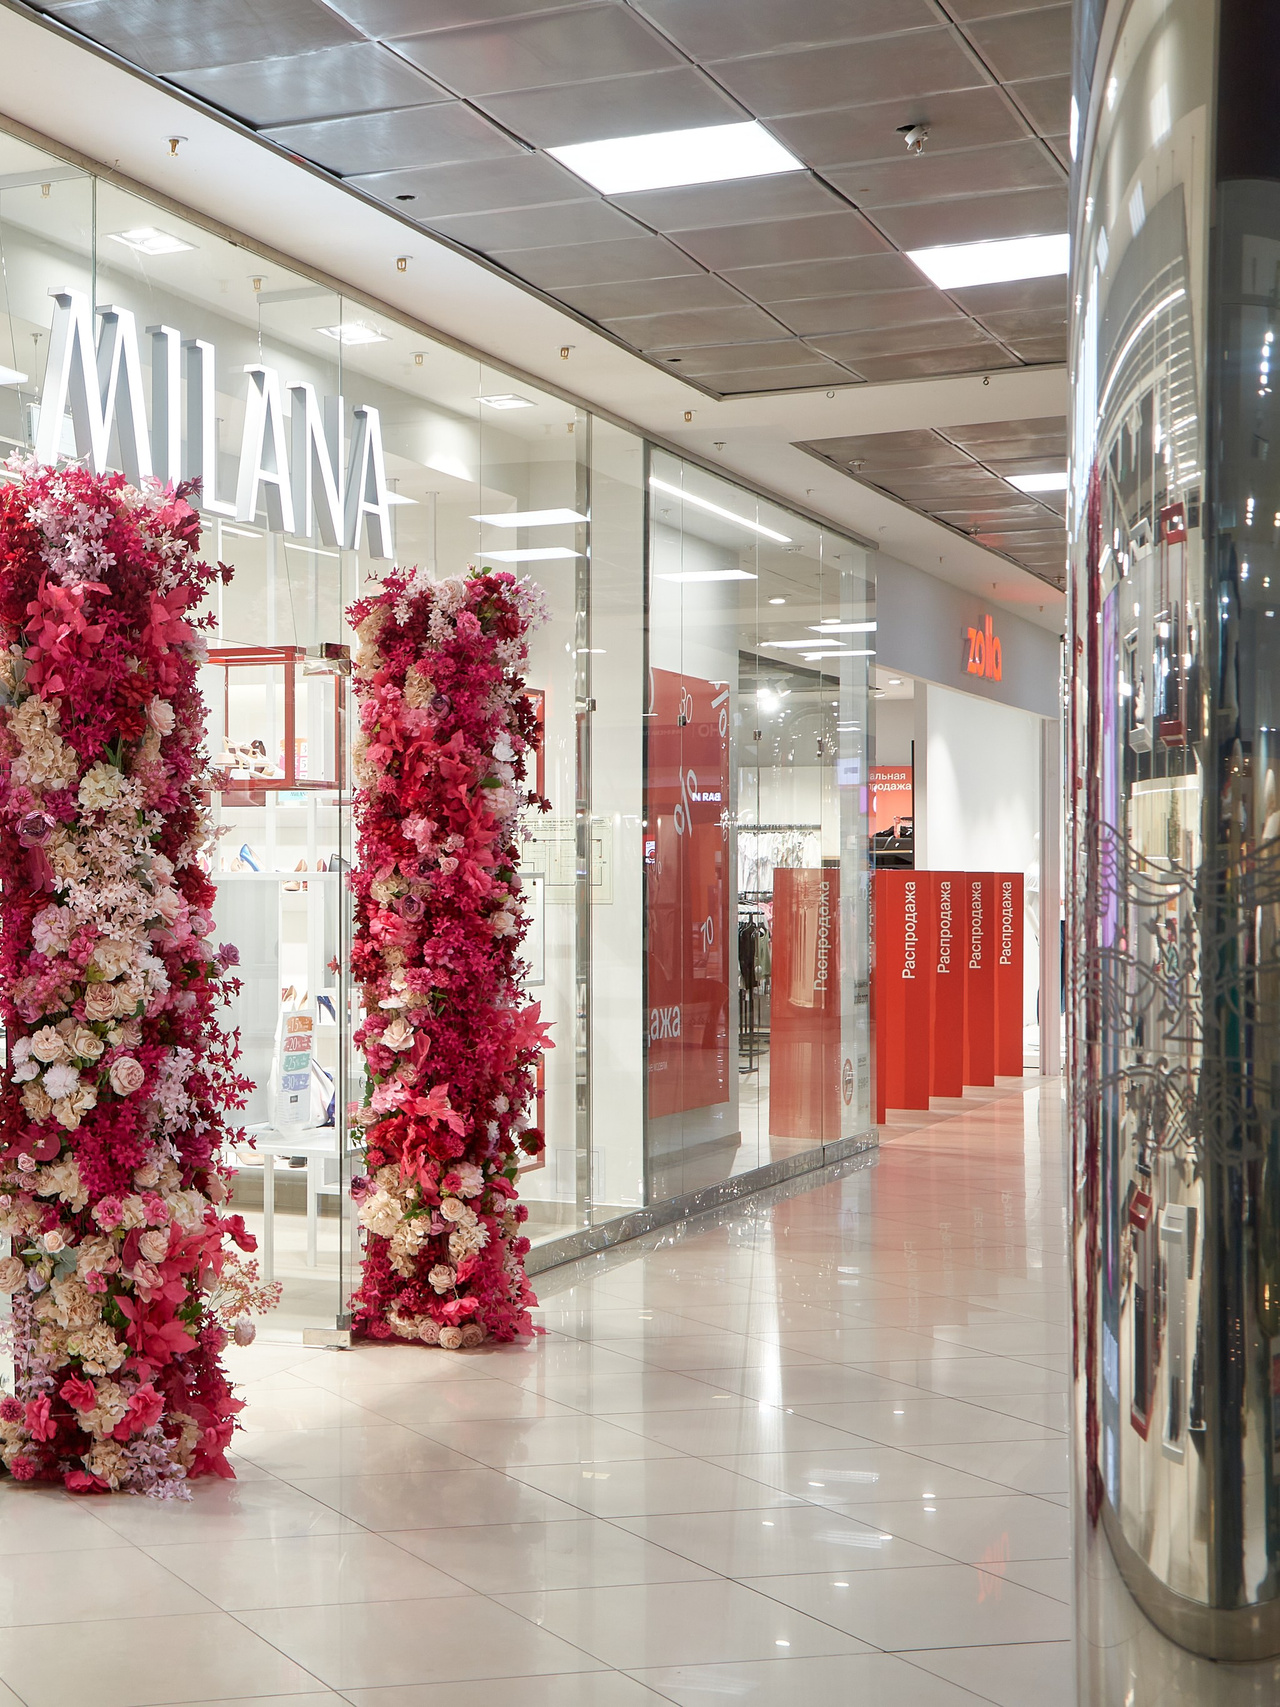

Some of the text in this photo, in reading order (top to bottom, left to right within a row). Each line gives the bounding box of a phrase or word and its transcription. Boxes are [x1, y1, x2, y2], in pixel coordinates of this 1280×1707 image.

[34, 285, 394, 560] MILANA
[966, 613, 1002, 682] zolla
[813, 881, 832, 991] Распродажа
[901, 881, 919, 979] Распродажа
[937, 881, 954, 974] Распродажа
[969, 881, 984, 969] Распродажа
[999, 881, 1014, 965] Распродажа
